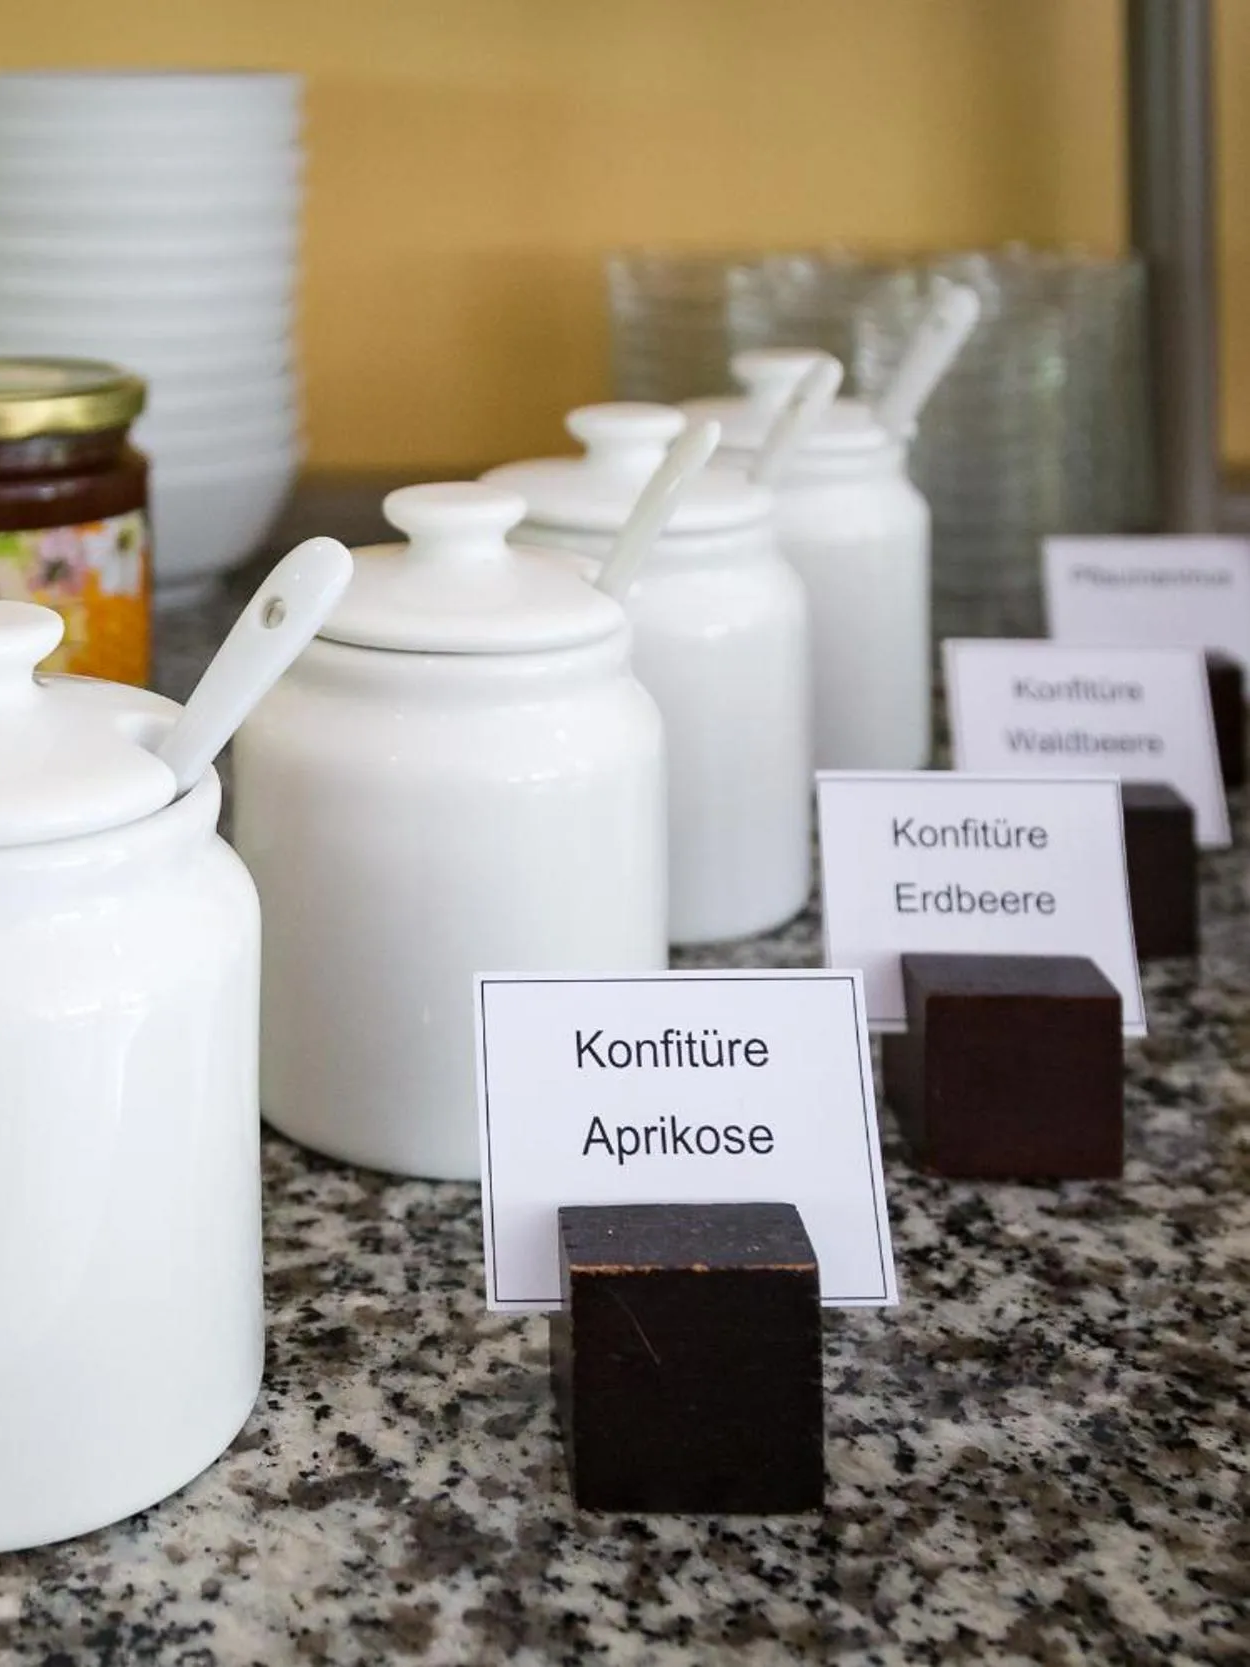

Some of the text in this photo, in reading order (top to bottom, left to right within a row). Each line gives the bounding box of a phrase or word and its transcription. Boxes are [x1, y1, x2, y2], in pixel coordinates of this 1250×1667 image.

[892, 817, 1048, 850] Konfitüre
[895, 883, 1056, 915] Erdbeere
[574, 1029, 769, 1069] Konfitüre
[582, 1116, 775, 1165] Aprikose
